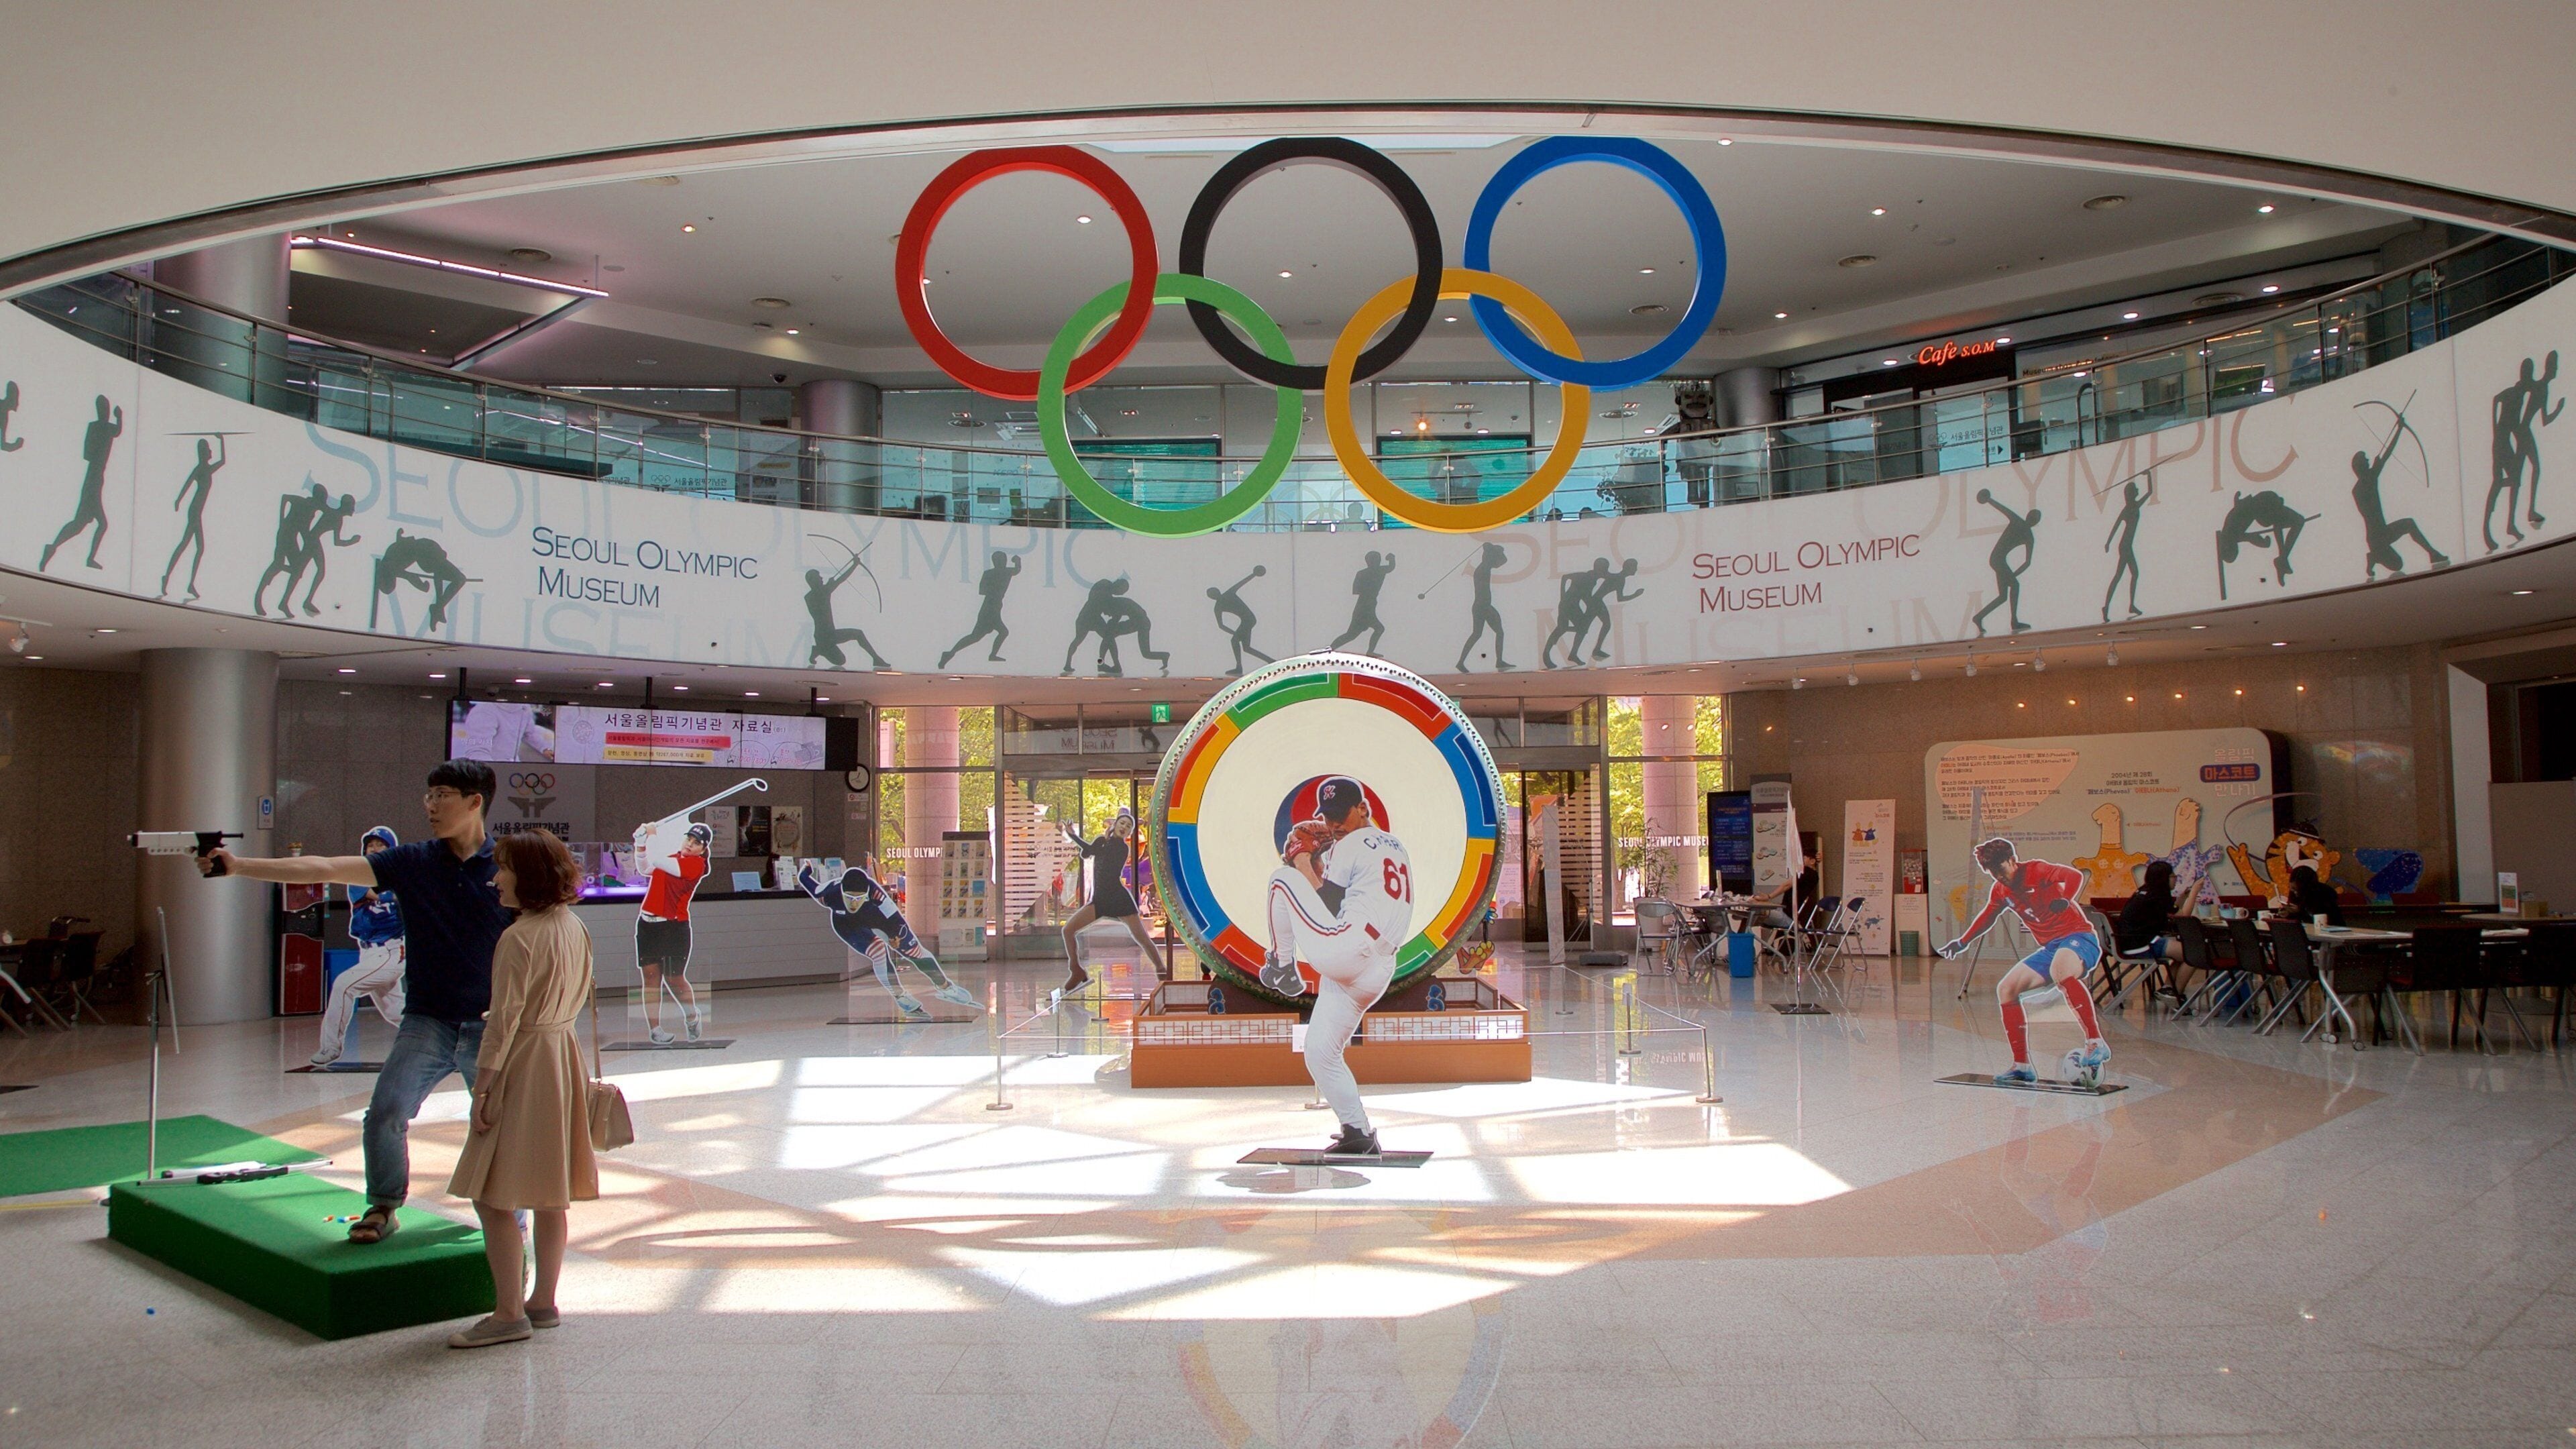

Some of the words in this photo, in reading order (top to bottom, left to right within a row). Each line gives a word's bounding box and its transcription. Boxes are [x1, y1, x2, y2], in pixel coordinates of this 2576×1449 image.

[1919, 341, 1957, 366] Cafe
[1961, 340, 1996, 357] S.O.M
[1951, 425, 2003, 441] 서울올림픽념관
[532, 526, 629, 567] SEOUL
[637, 541, 759, 580] OLYMPIC
[1693, 553, 1790, 580] SEOUL
[1797, 535, 1920, 569] OLYMPIC
[538, 566, 659, 608] MUSEUM
[1700, 582, 1822, 613] MUSEUM
[604, 713, 722, 731] 서울올림픽기념관
[732, 719, 772, 734] 자료실
[2214, 748, 2255, 763] 올림픽
[2204, 765, 2257, 781] 마스코트
[1683, 835, 1709, 847] MUSE
[886, 847, 912, 859] SEOUL
[914, 847, 943, 858] OLYMPI
[1383, 858, 1411, 904] 61
